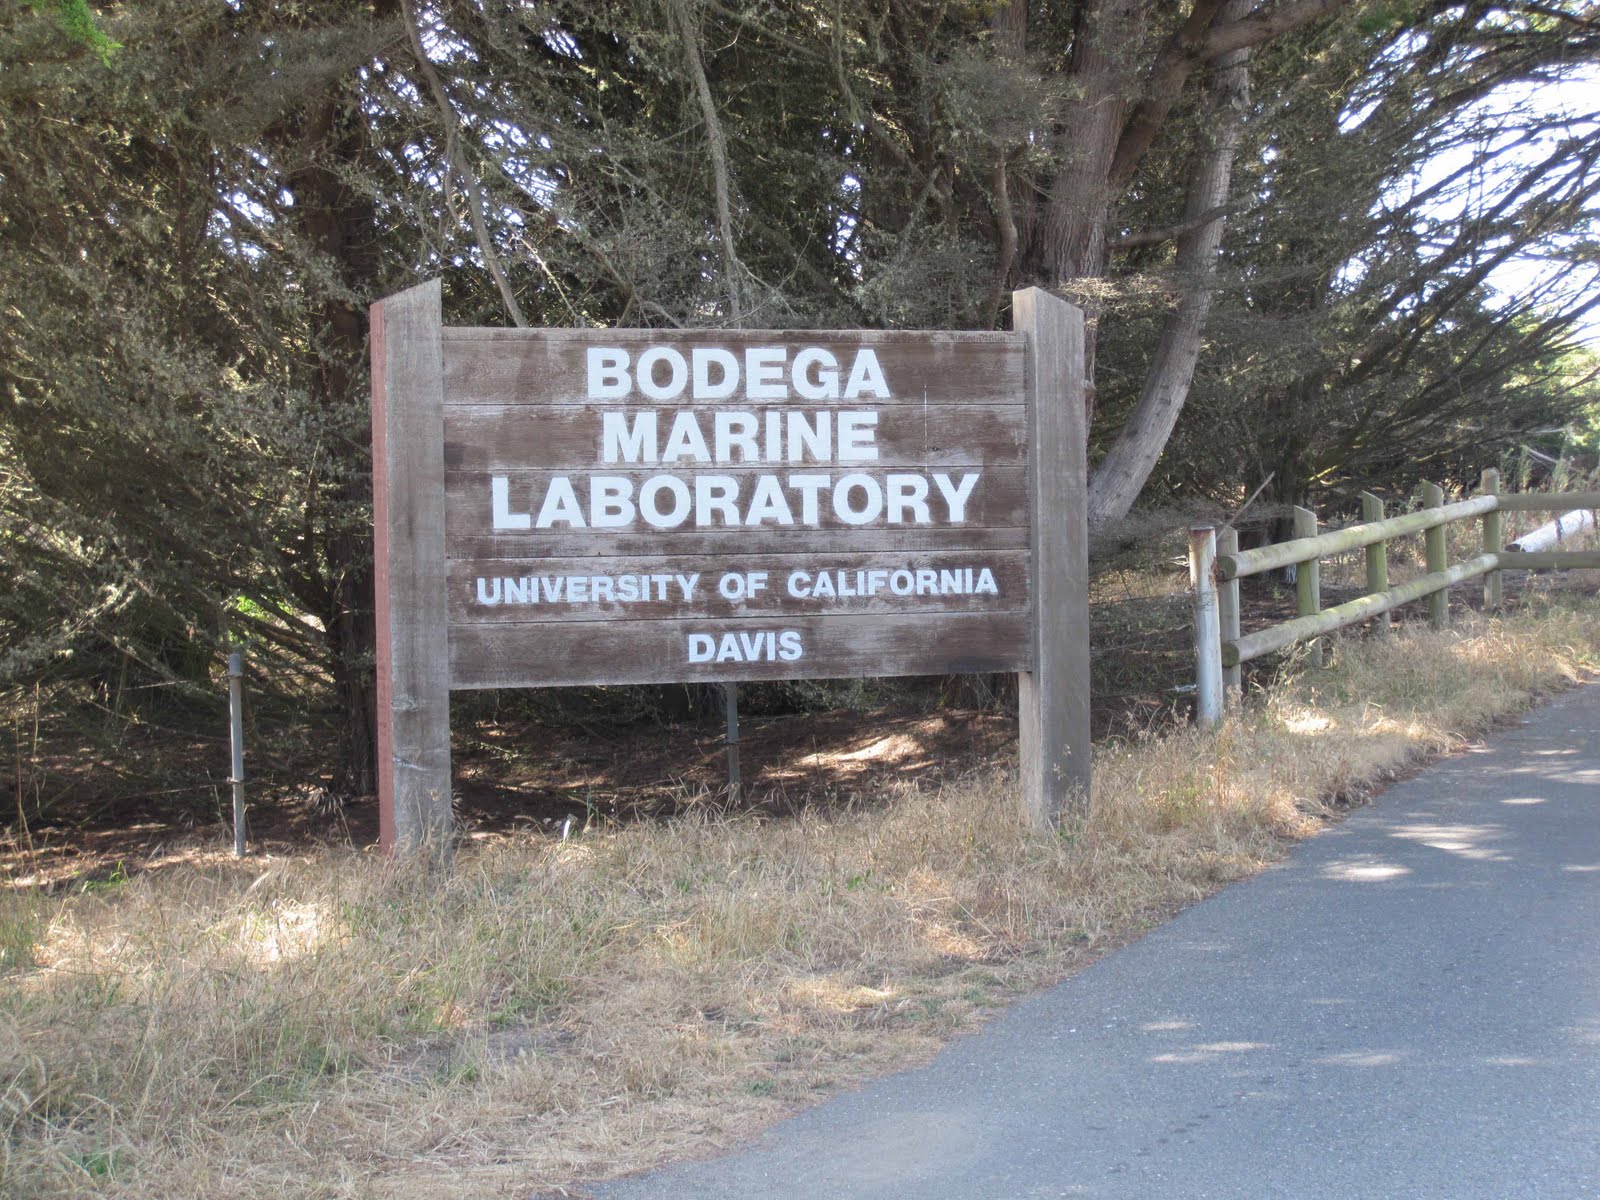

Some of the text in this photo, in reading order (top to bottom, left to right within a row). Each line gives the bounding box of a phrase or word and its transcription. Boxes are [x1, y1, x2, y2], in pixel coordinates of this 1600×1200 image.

[586, 347, 891, 399] BODEGA
[603, 411, 880, 464] MARINE
[491, 474, 979, 529] LABORATORY
[476, 568, 999, 605] UNIVERSITY OF CALIFORNIA
[687, 631, 804, 664] DAVIS
